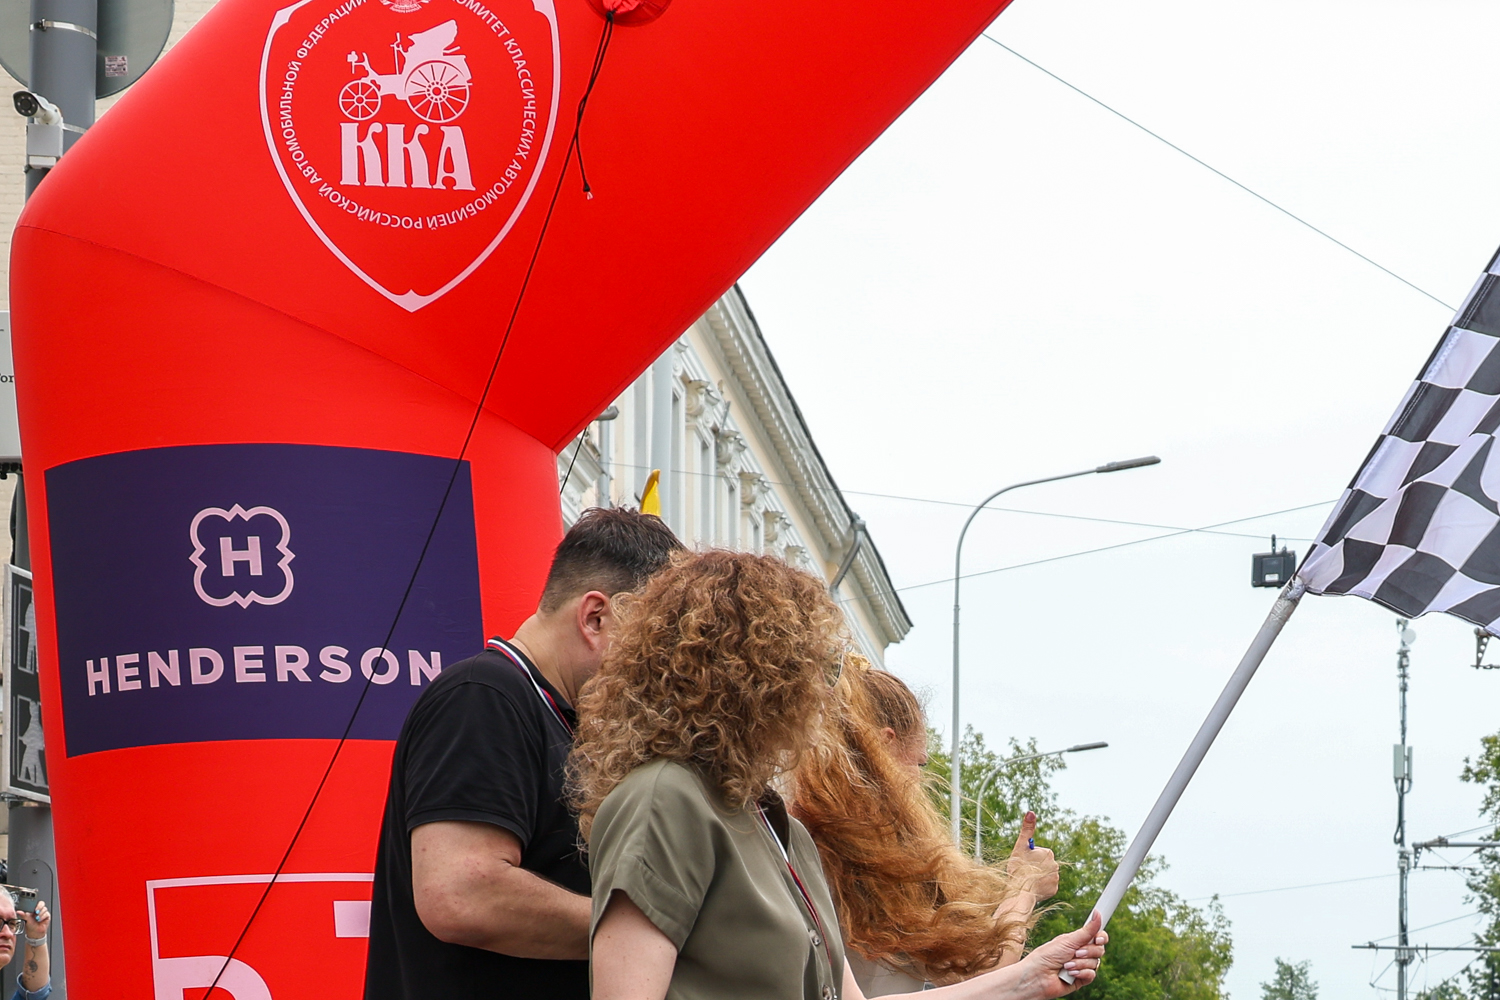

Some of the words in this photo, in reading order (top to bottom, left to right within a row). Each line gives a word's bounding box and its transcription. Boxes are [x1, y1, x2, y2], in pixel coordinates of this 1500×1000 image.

[279, 60, 322, 184] АВТОМОБИЛЬНОЙ
[504, 38, 536, 160] КЛАССИЧЕСКИХ
[339, 121, 477, 191] ККА
[318, 182, 423, 229] РОССИЙСКОЙ
[426, 159, 522, 231] АВТОМОБИЛЕЙ
[219, 535, 263, 577] H
[86, 645, 443, 697] HENDERSON
